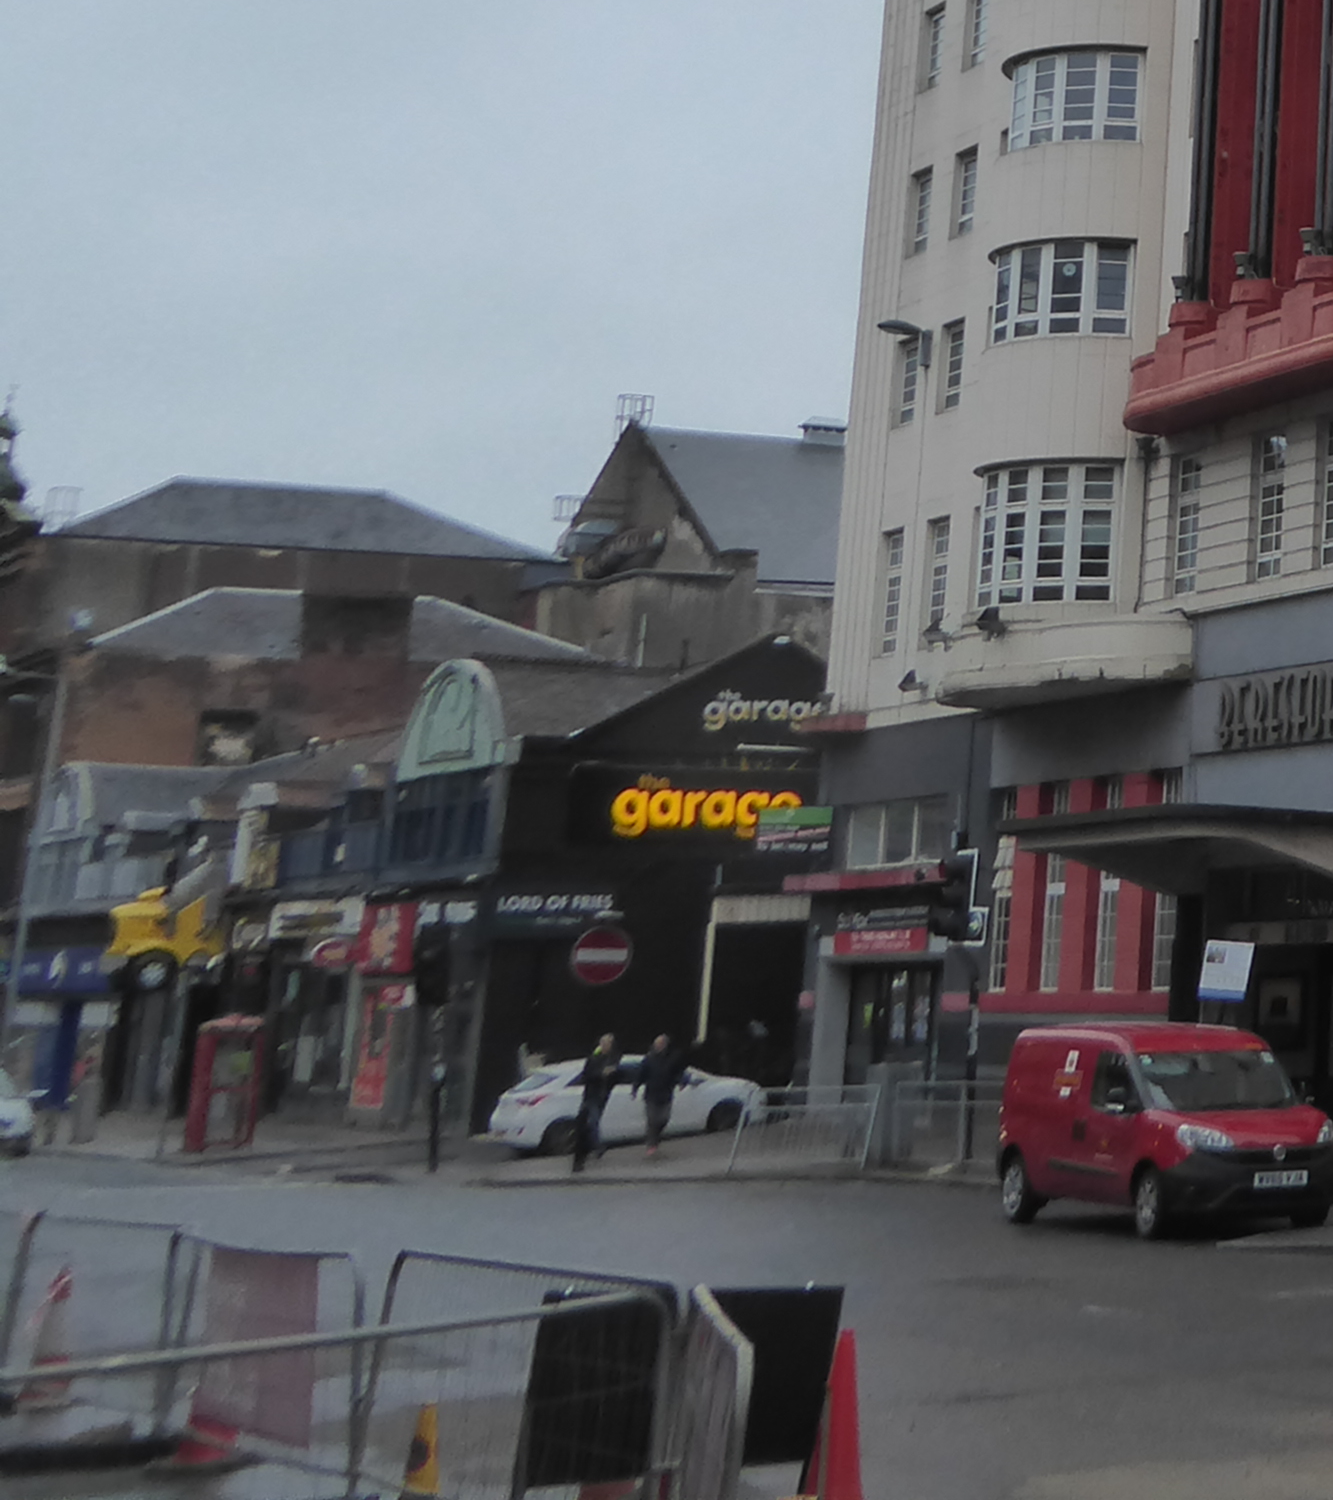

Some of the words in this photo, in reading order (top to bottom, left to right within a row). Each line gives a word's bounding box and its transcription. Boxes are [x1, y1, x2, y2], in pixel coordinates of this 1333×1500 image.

[497, 895, 544, 912] LORD
[546, 893, 570, 910] OF
[571, 893, 614, 910] FRIES
